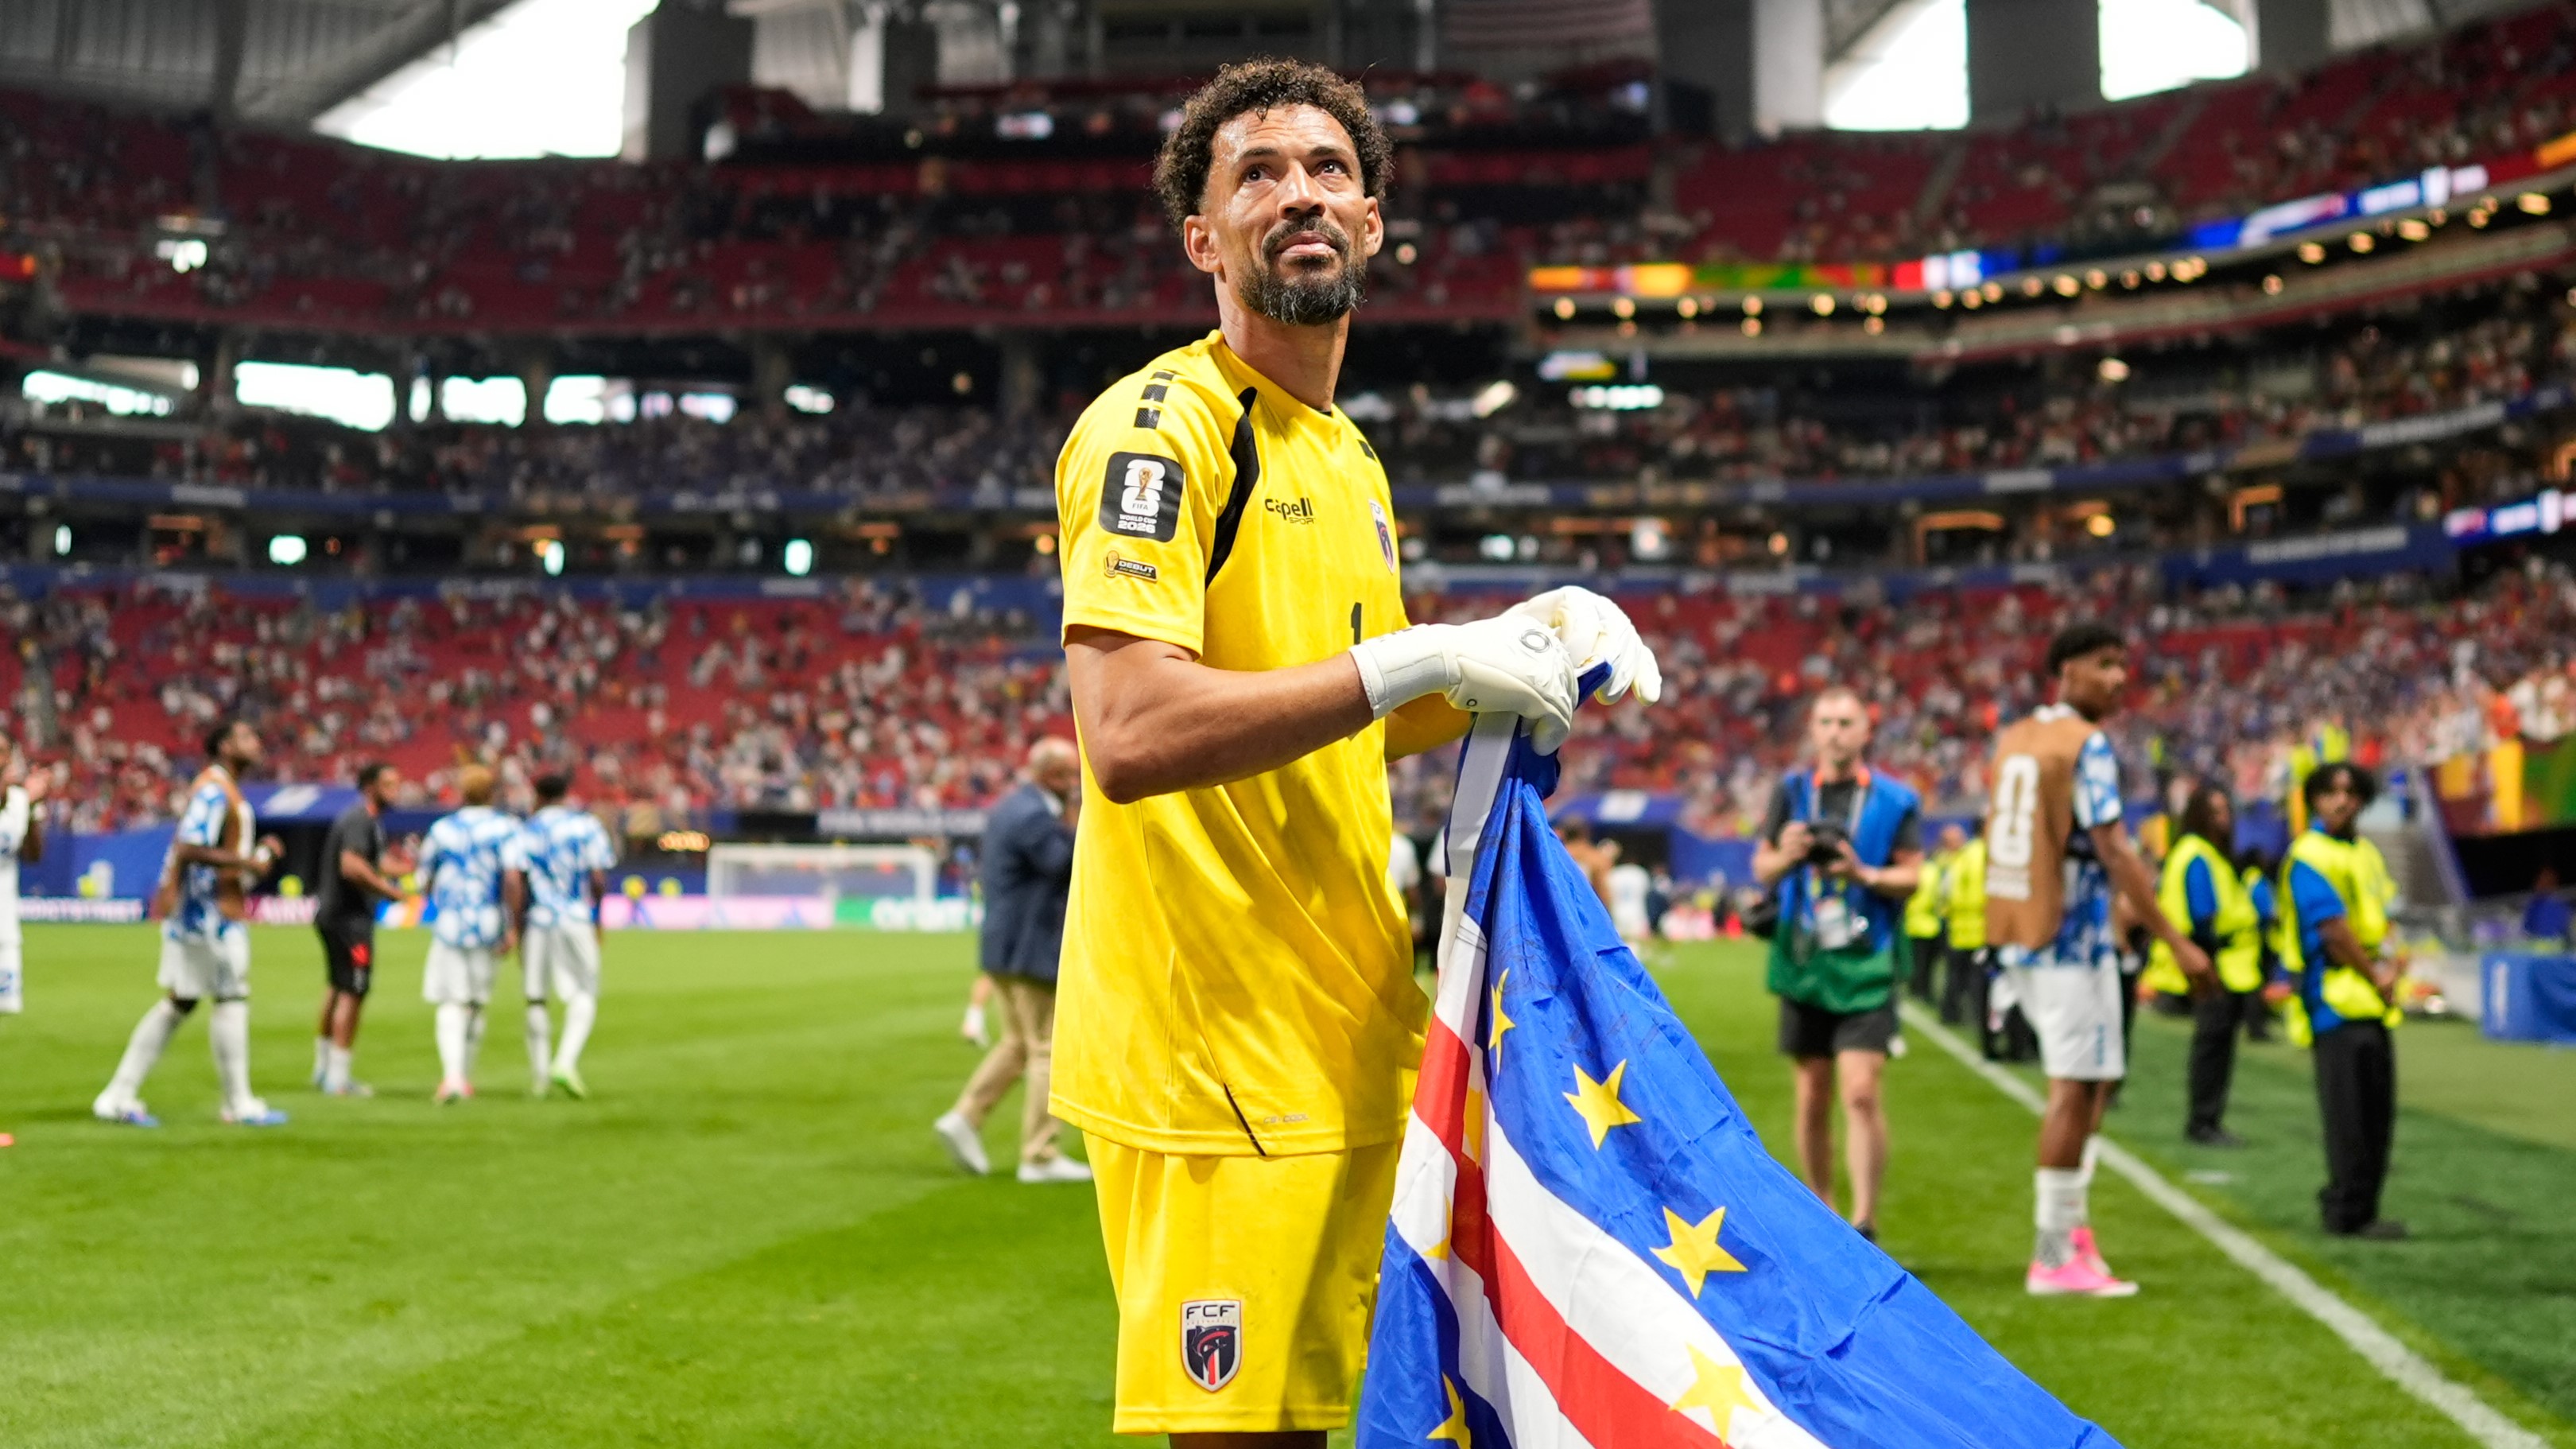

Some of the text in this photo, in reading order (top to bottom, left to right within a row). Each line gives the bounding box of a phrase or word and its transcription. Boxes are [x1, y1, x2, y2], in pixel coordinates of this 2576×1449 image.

[1132, 502, 1149, 511] FIFA
[1119, 514, 1143, 522] WORLD
[1117, 520, 1156, 534] 2026
[1119, 560, 1155, 574] DEBUT
[1351, 601, 1362, 645] 1
[1186, 1304, 1236, 1320] FCF
